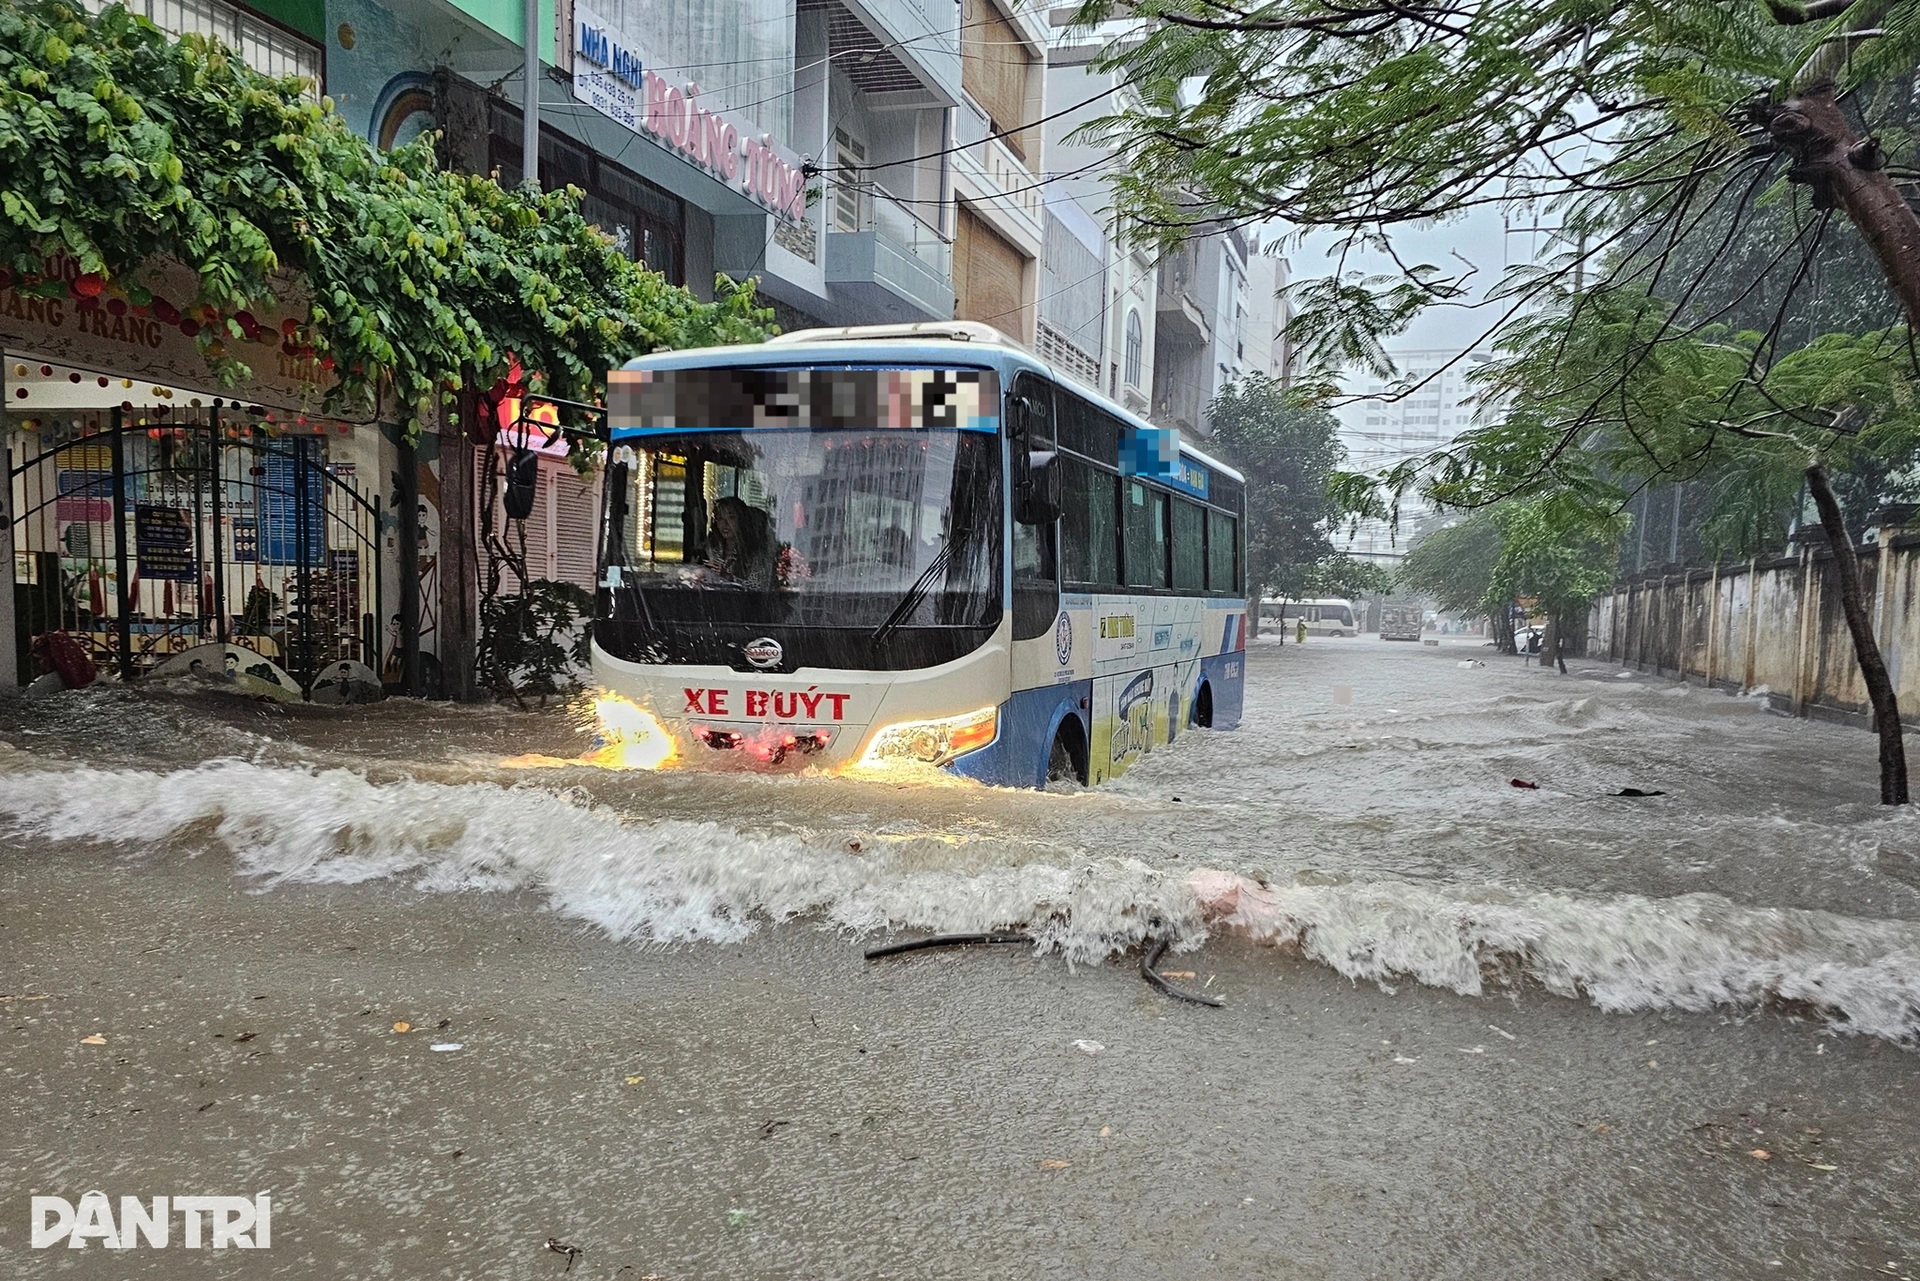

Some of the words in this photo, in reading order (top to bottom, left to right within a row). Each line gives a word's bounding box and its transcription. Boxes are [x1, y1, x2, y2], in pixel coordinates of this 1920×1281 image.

[644, 70, 739, 180] HOÀNG
[742, 134, 805, 221] TÙNG
[0, 288, 65, 327] ANG
[747, 648, 779, 657] SAMCO
[683, 688, 729, 715] XE
[746, 685, 850, 720] BUÝT
